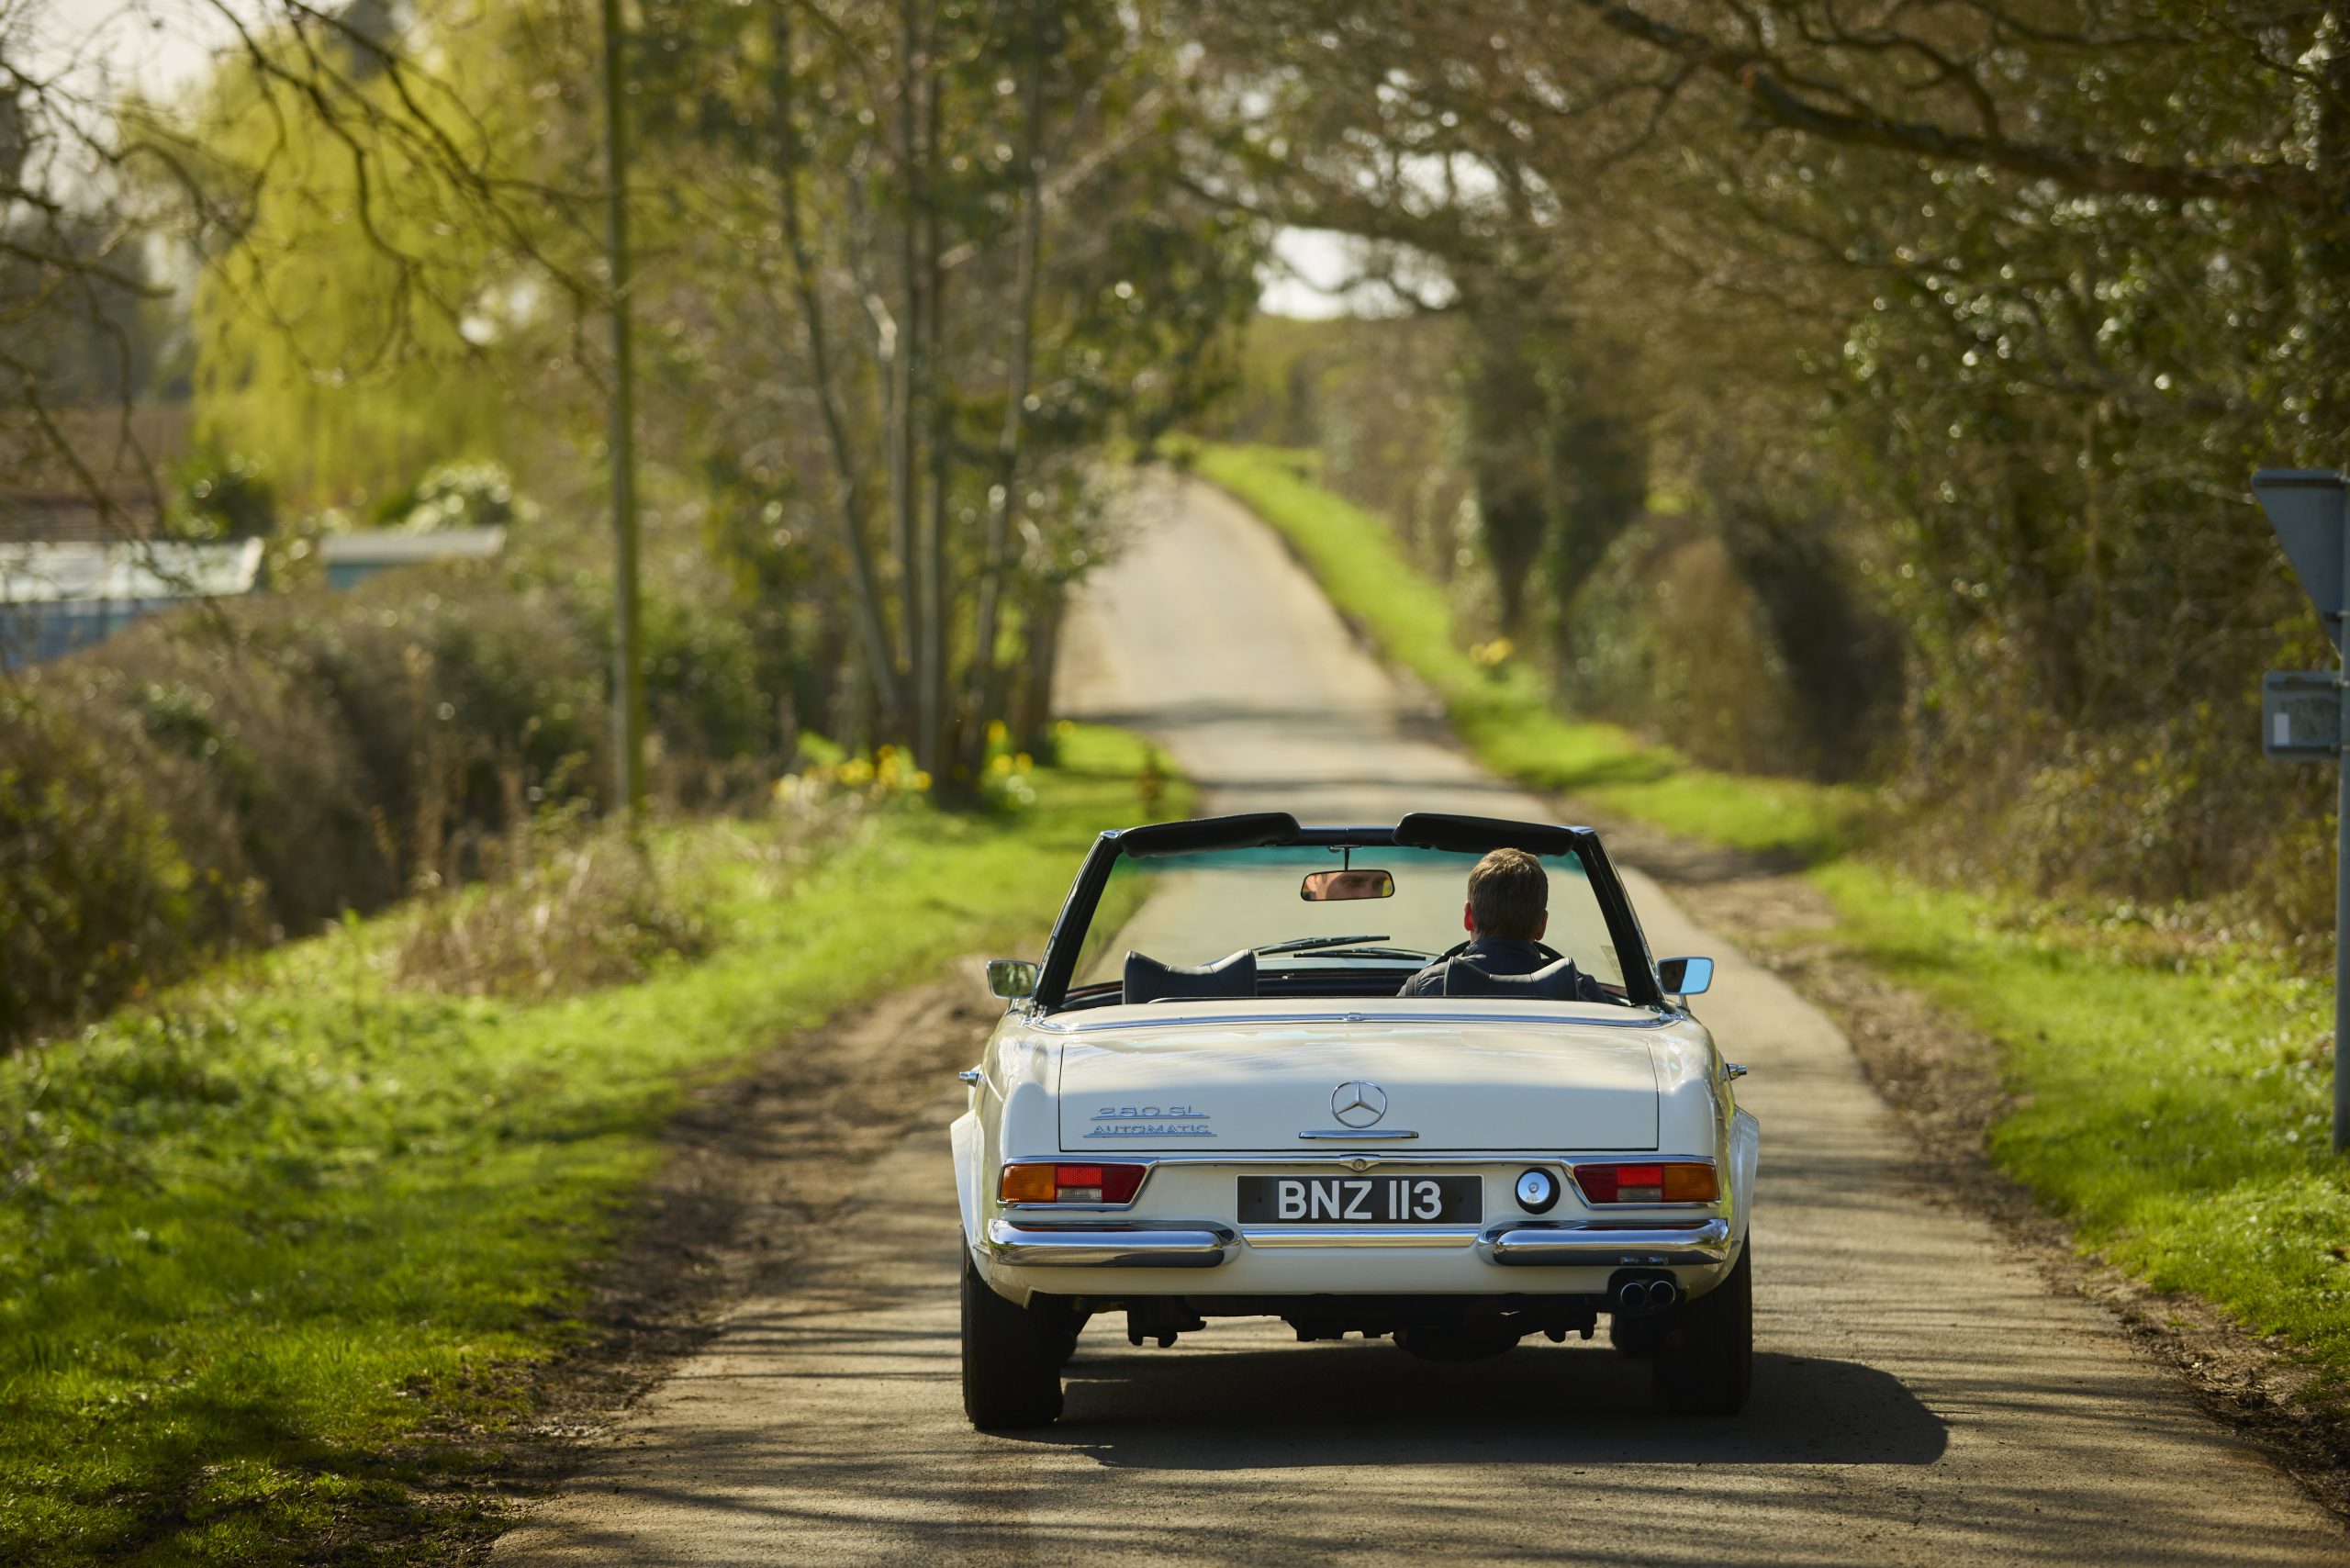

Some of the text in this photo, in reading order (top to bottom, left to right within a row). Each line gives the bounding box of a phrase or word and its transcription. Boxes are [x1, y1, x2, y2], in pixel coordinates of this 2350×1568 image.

[1169, 1104, 1203, 1116] SL
[1093, 1125, 1210, 1134] AUTOMATIC
[1278, 1180, 1442, 1219] BNZ 113
